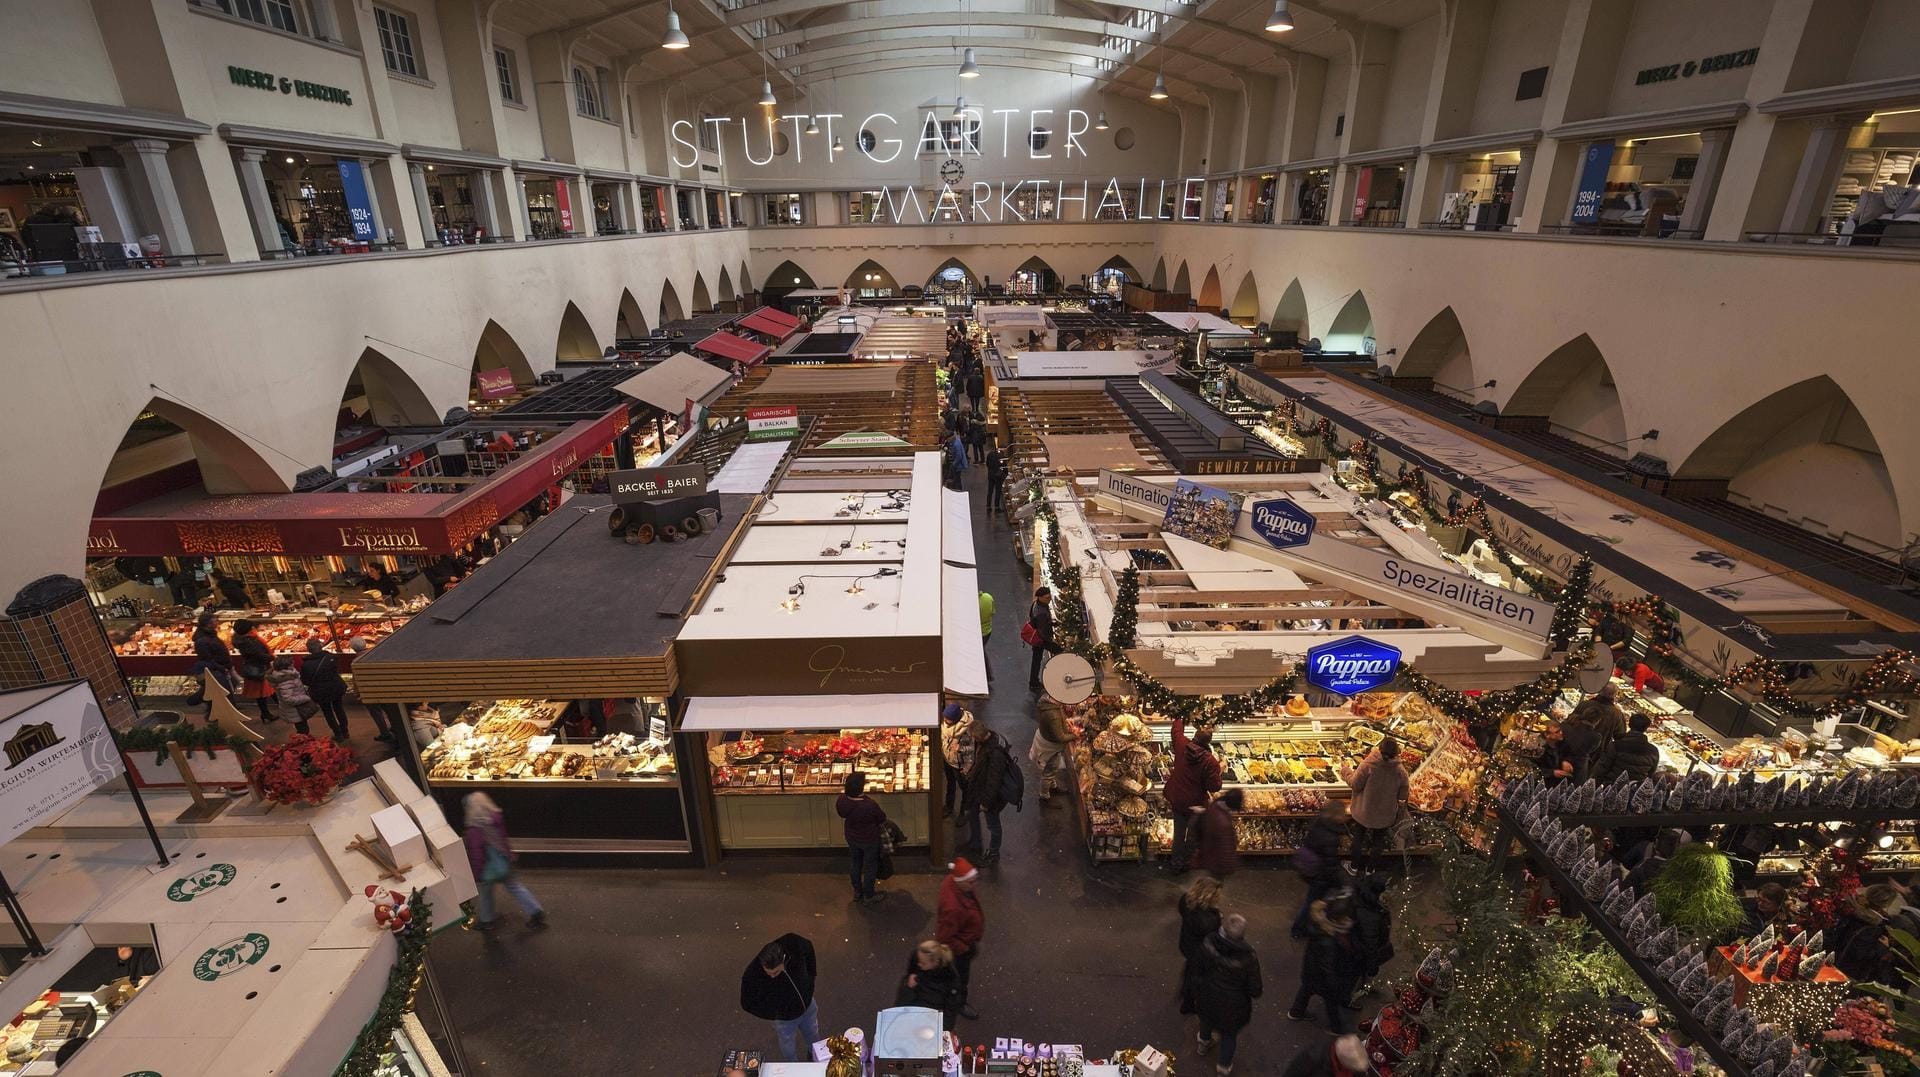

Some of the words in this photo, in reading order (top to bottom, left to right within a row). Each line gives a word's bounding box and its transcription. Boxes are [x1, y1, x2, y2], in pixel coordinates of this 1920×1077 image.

[1635, 63, 1681, 86] MERZ
[1682, 60, 1698, 78] &
[228, 65, 277, 92] MERZ
[279, 77, 292, 95] &
[294, 79, 353, 107] BENZING
[871, 176, 1206, 223] MARKTHALLE
[1578, 191, 1601, 204] 1994-
[351, 208, 371, 221] 1924-
[1574, 205, 1595, 217] 2004
[355, 222, 372, 235] 1934
[752, 408, 792, 418] UNGARISCHE
[764, 420, 788, 428] BALKAN
[1198, 460, 1249, 474] GEWÜRZ
[1255, 460, 1297, 473] MAYER
[617, 481, 657, 493] BÄCKER
[667, 477, 699, 488] BAIER
[1256, 506, 1307, 536] Pappas
[1108, 475, 1173, 507] Internatio
[1383, 560, 1535, 625] Spezialitäten
[1511, 527, 1555, 563] Feinkost
[1317, 654, 1391, 679] Pappas
[0, 765, 36, 792] EGIUM
[38, 729, 102, 770] WIRTEMBERG
[40, 793, 55, 804] 0711
